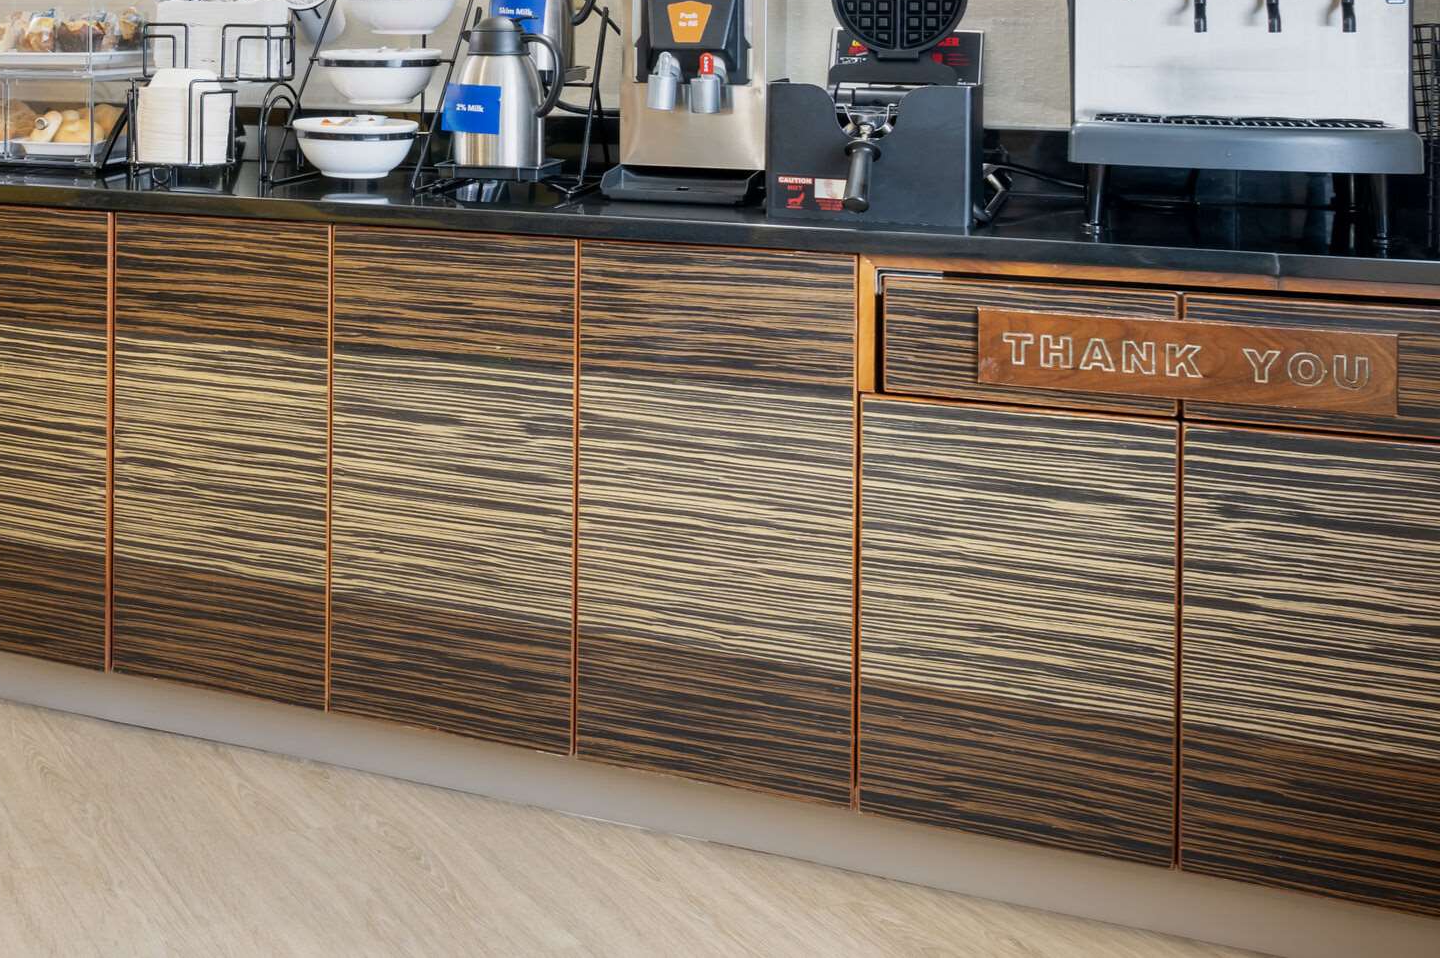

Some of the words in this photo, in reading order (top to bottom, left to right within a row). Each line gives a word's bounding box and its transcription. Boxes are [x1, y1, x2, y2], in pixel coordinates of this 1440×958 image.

[498, 6, 515, 15] Skim
[515, 8, 534, 17] Milk
[456, 103, 467, 112] 2%
[467, 104, 484, 113] Milk
[778, 176, 813, 185] CAUTION
[1002, 332, 1204, 379] THANK
[1242, 347, 1371, 391] YOU
